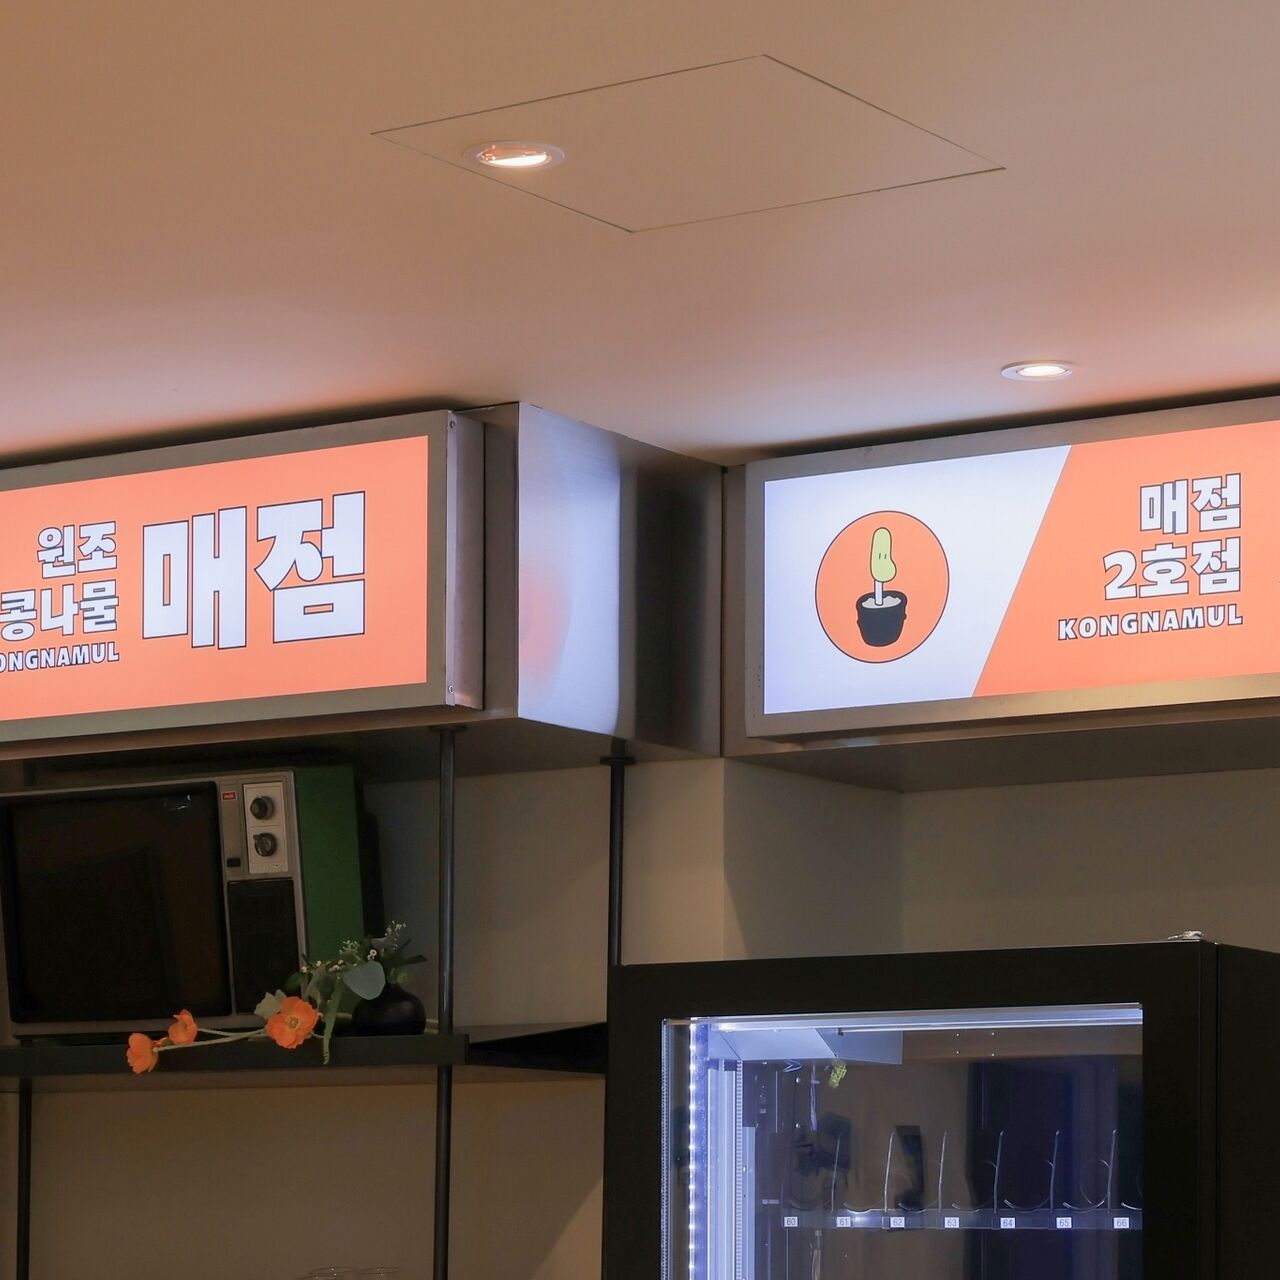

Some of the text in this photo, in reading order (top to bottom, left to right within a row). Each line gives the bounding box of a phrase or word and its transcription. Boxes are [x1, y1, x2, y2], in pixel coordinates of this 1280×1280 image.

[1139, 473, 1242, 536] 매점
[37, 520, 119, 579] 원조
[142, 491, 366, 650] 매점
[1103, 540, 1242, 602] 2호점
[0, 579, 119, 642] 콩나물
[1057, 602, 1243, 642] KONGNAMUL
